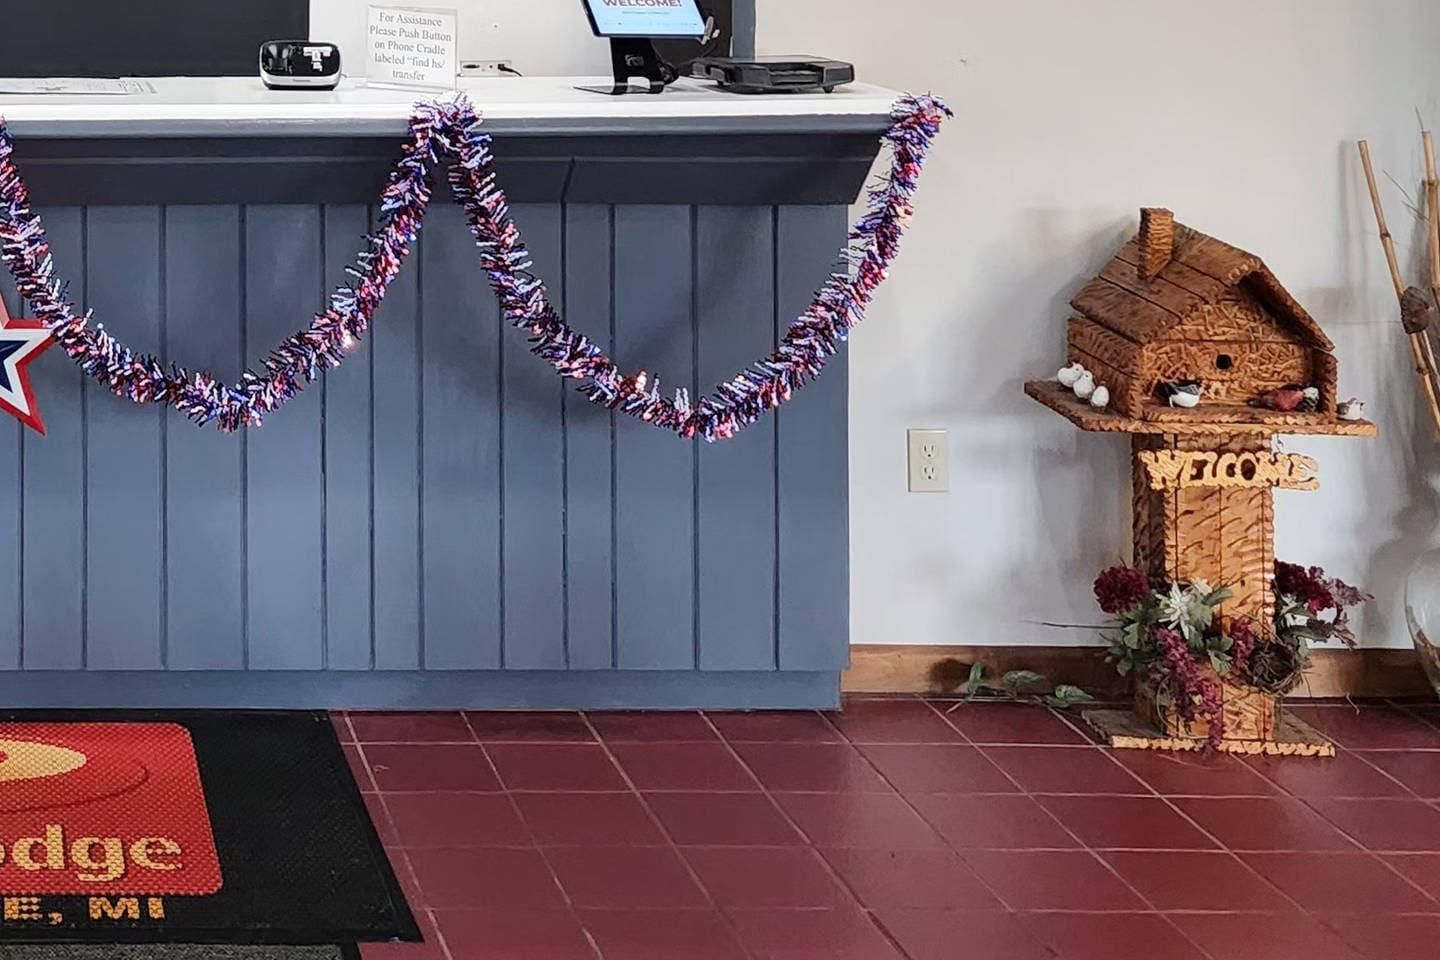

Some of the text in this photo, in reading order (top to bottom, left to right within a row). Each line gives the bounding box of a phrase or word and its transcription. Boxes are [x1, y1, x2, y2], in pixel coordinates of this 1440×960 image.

[379, 11, 443, 27] For Assistance
[369, 25, 452, 42] Please Push Button
[374, 40, 446, 56] on Phone Cradle
[374, 52, 406, 65] labeled
[392, 69, 425, 81] transfer
[1139, 449, 1320, 491] WELCOME
[88, 897, 166, 920] MI
